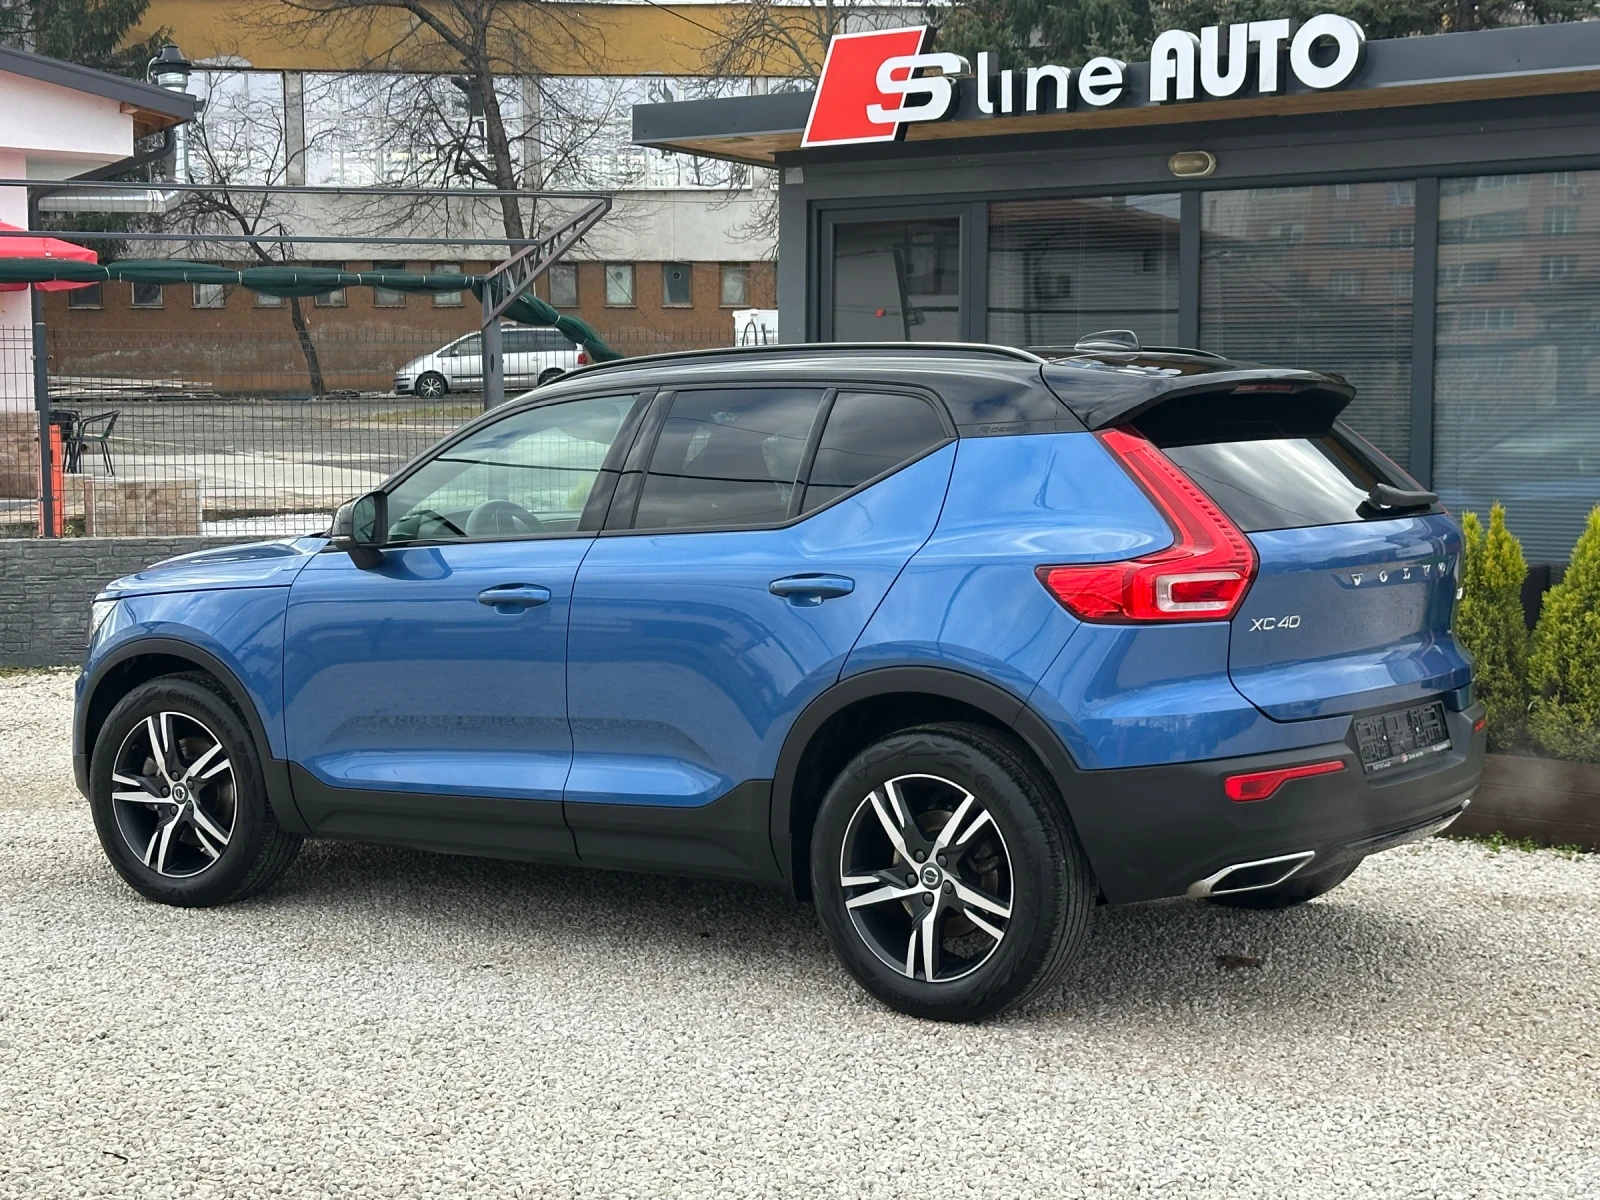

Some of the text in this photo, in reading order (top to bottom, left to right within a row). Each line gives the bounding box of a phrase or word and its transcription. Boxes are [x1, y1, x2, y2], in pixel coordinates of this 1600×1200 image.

[866, 13, 1360, 124] S line AUTO
[1351, 562, 1446, 586] VOLVO
